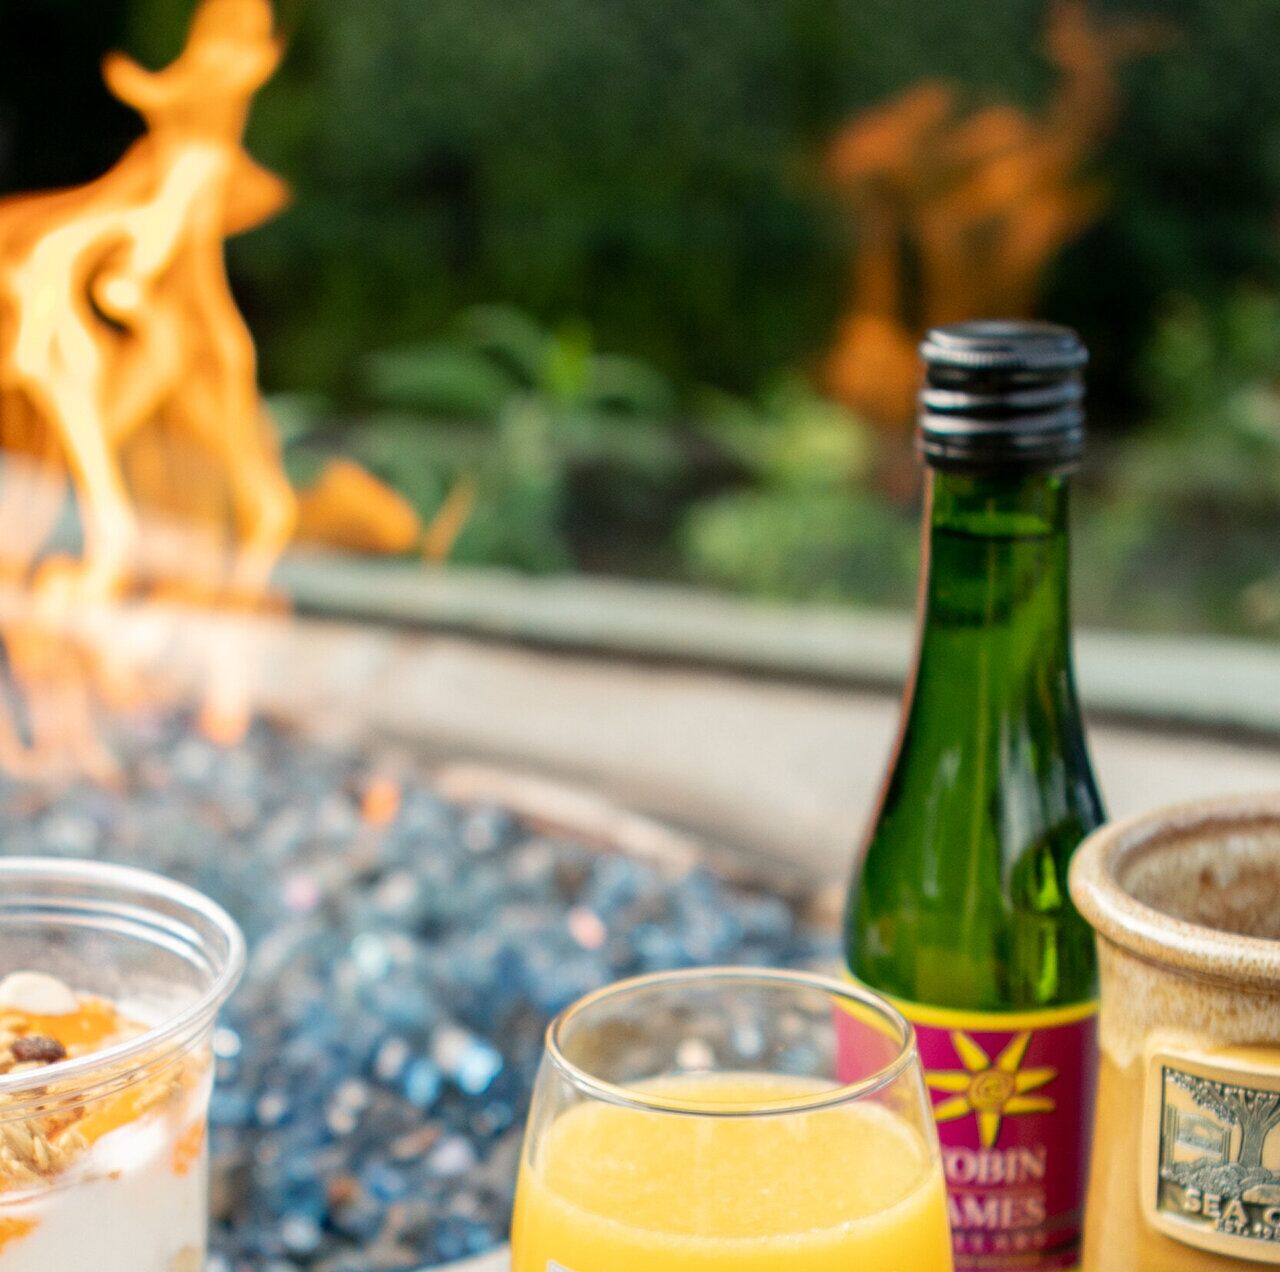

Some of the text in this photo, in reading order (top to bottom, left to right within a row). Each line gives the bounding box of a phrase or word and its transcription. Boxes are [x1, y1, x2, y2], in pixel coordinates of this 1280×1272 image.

[943, 1148, 1046, 1183] OBIN
[947, 1195, 1046, 1229] AMES
[1183, 1187, 1248, 1224] SEA
